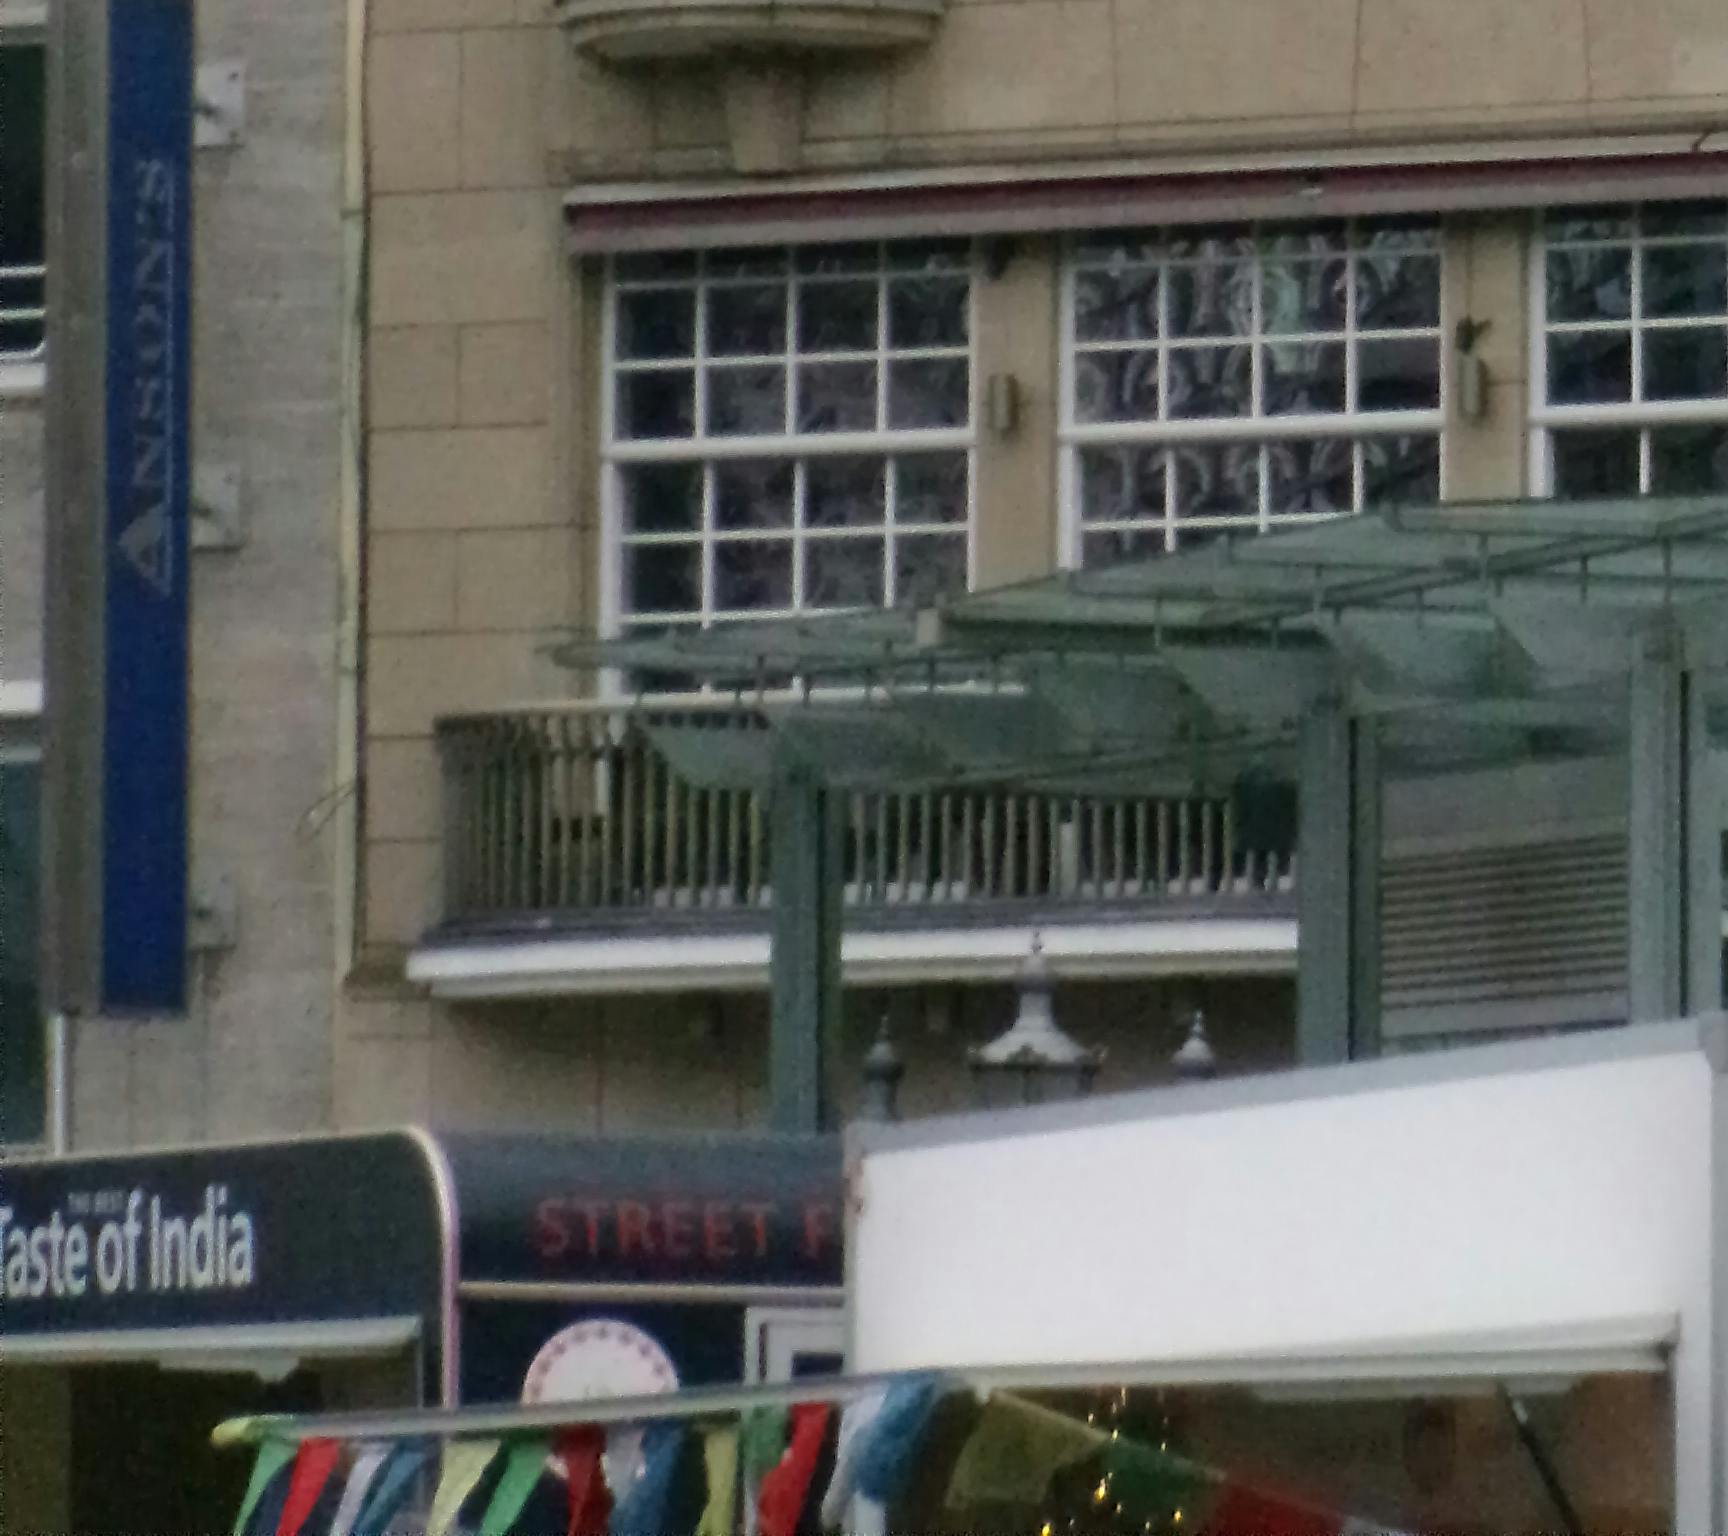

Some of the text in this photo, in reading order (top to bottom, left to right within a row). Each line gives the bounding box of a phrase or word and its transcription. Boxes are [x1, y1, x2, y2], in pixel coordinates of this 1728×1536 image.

[117, 158, 174, 596] ANSON'S
[97, 1184, 143, 1293] of
[151, 1183, 255, 1289] India
[536, 1197, 778, 1258] STREET
